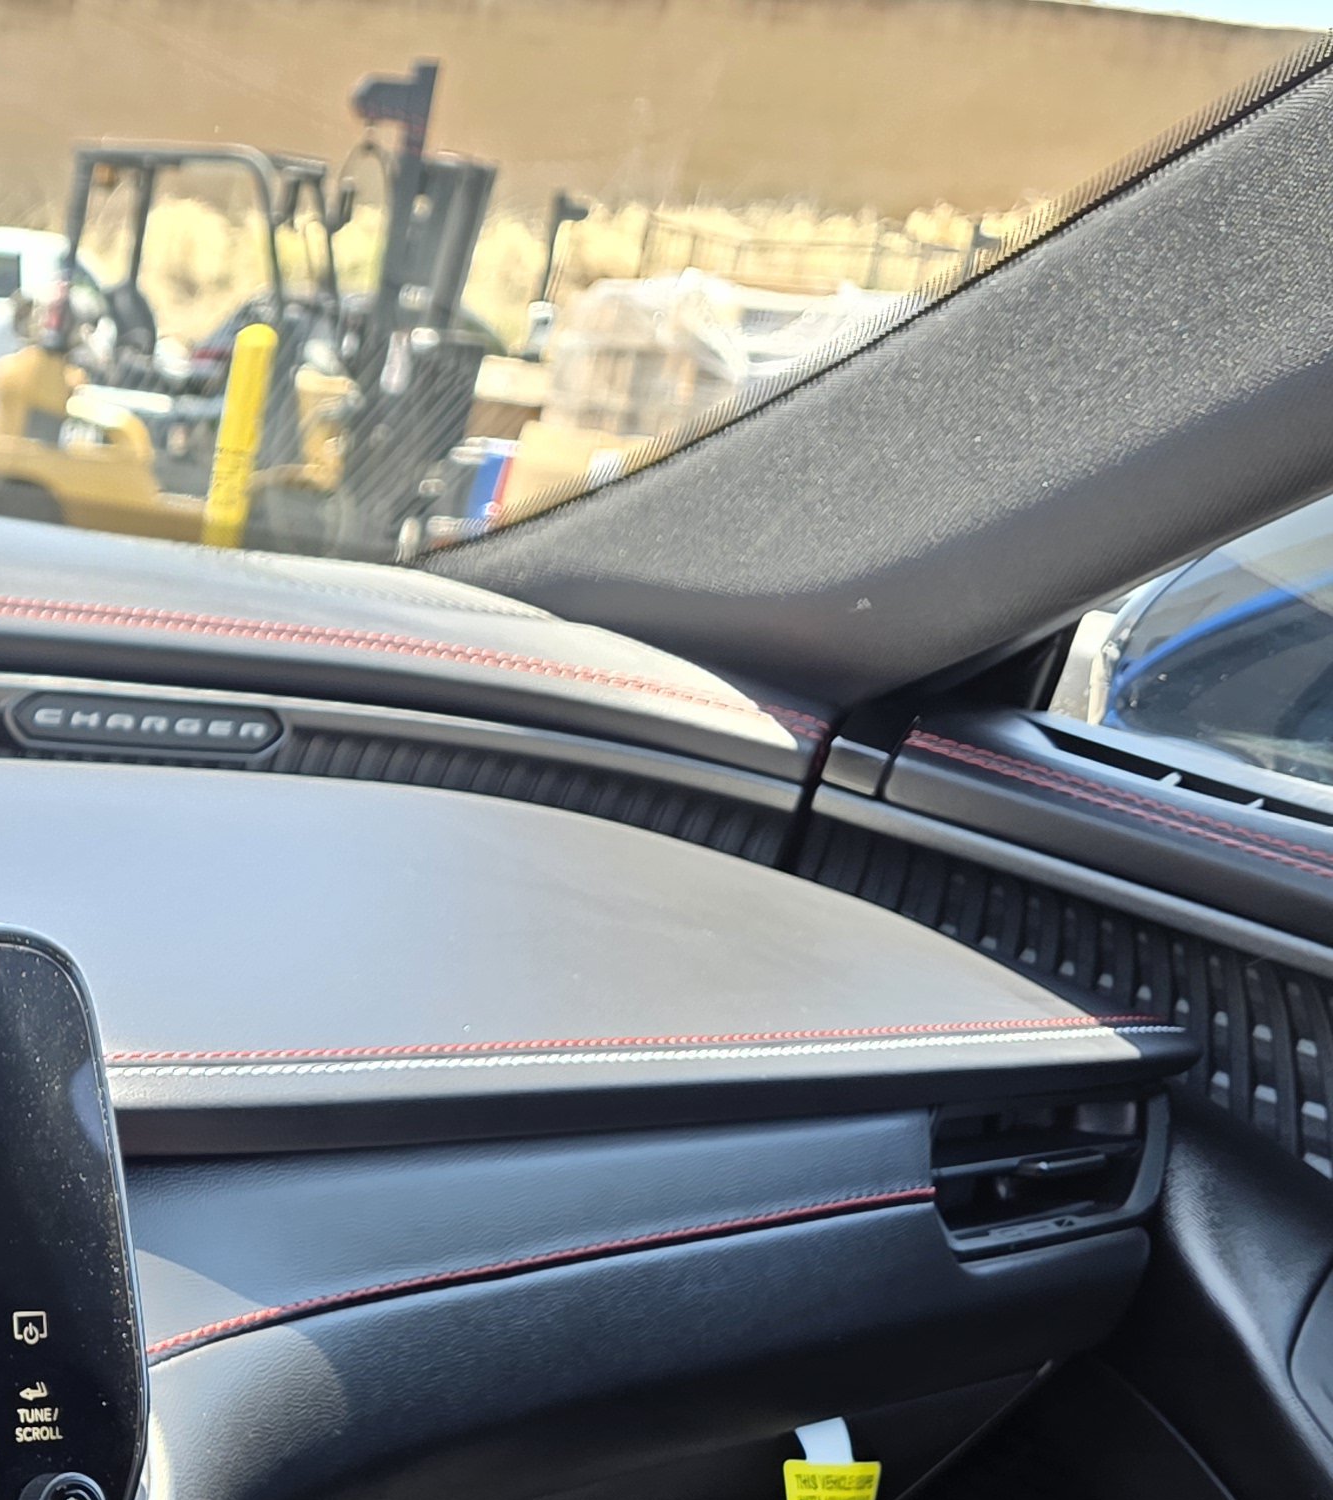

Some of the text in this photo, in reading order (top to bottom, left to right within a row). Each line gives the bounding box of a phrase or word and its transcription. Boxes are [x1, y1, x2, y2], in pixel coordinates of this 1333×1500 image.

[34, 707, 269, 739] CHARGER
[16, 1407, 59, 1423] TUNE/
[15, 1425, 63, 1443] SCROLL
